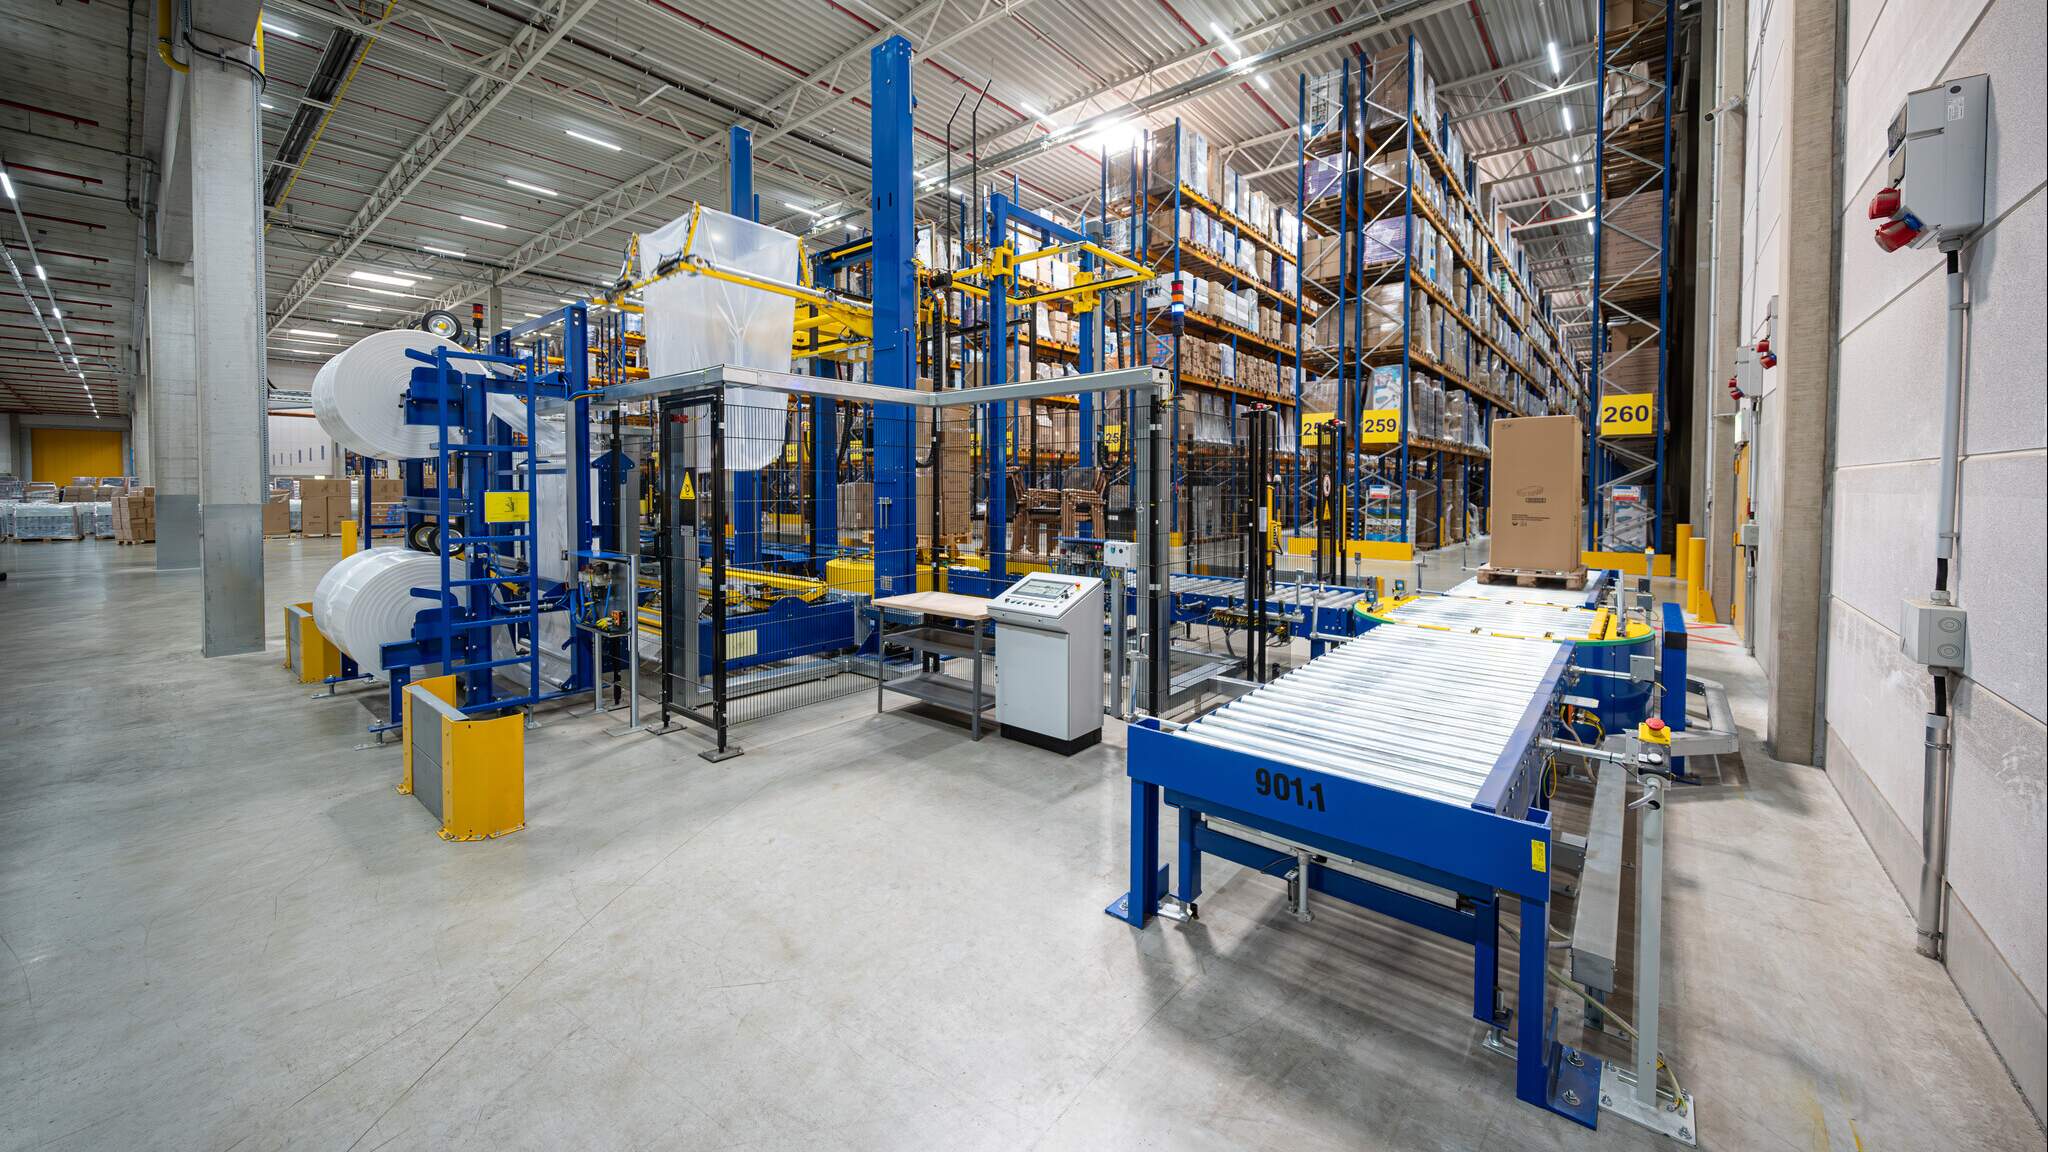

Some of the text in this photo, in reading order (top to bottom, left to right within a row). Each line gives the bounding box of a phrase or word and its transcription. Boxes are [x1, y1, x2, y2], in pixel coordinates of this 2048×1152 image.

[1603, 405, 1649, 423] 260
[1364, 418, 1397, 433] 259
[1255, 767, 1326, 812] 901.1
